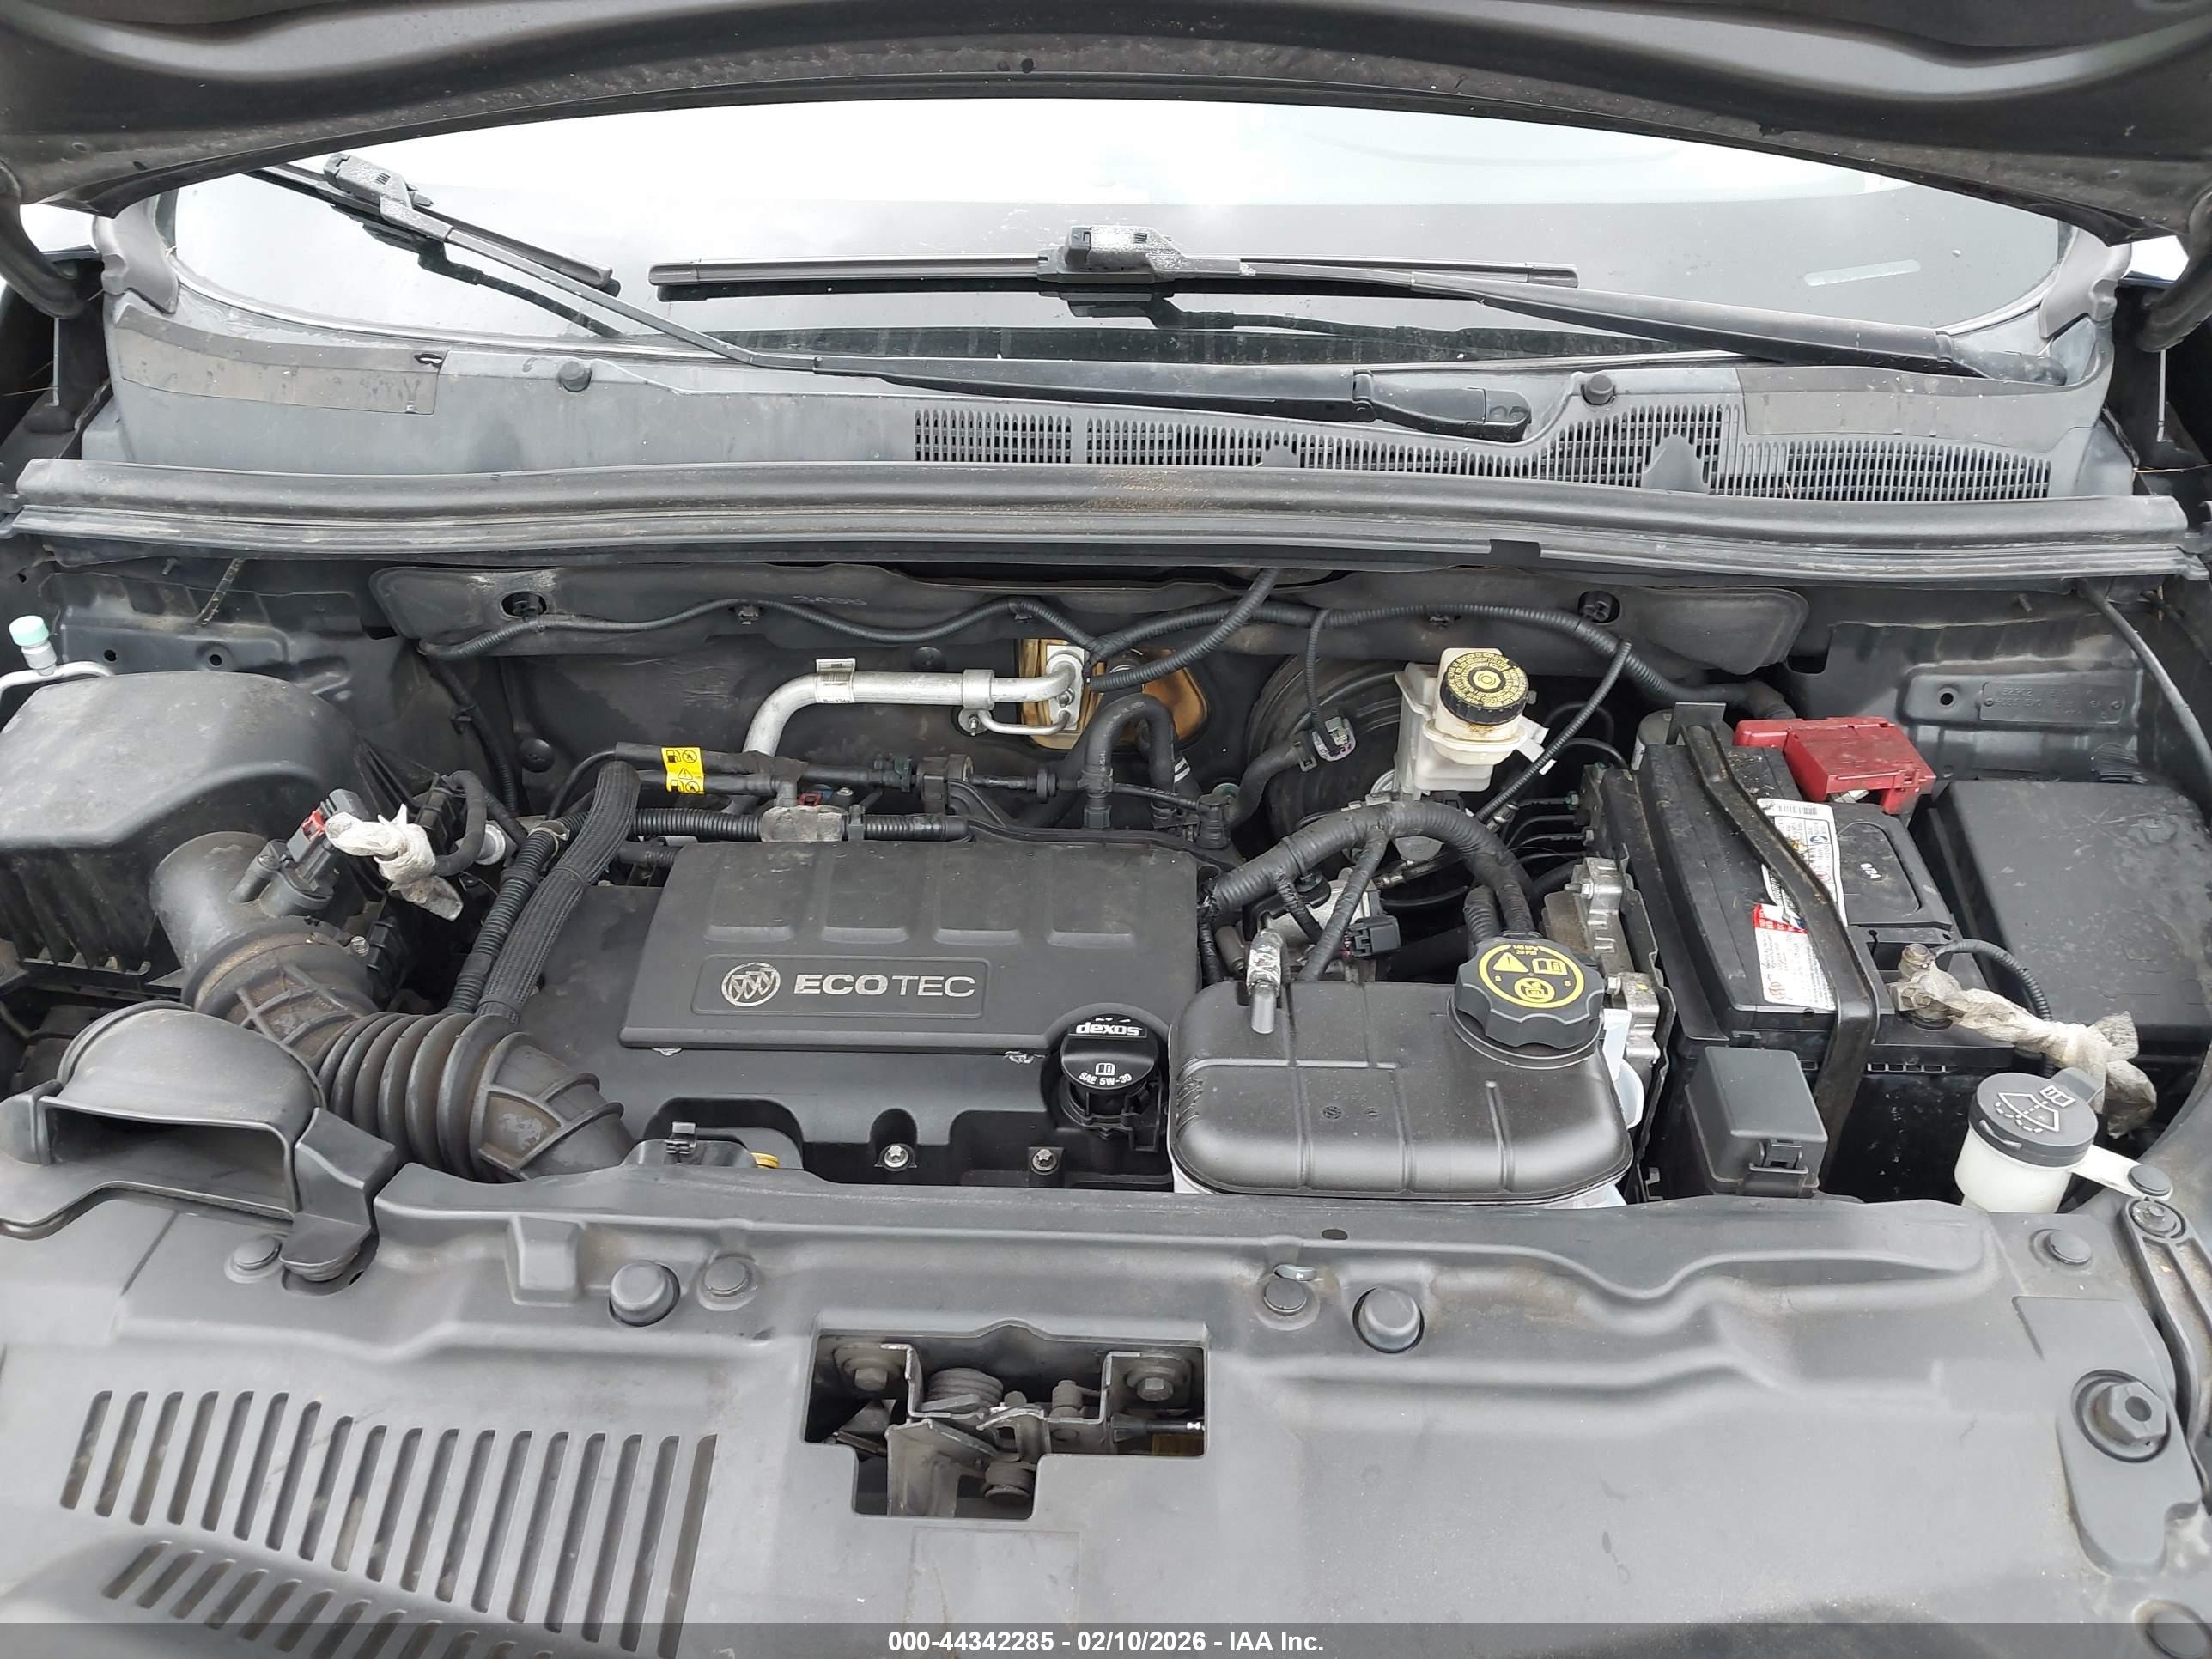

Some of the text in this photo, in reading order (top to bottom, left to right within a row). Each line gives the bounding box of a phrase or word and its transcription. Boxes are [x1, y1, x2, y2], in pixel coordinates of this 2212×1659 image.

[794, 974, 976, 997] ECOTEC
[1076, 1022, 1143, 1036] dexos
[1079, 1072, 1133, 1086] SAE 5W-30
